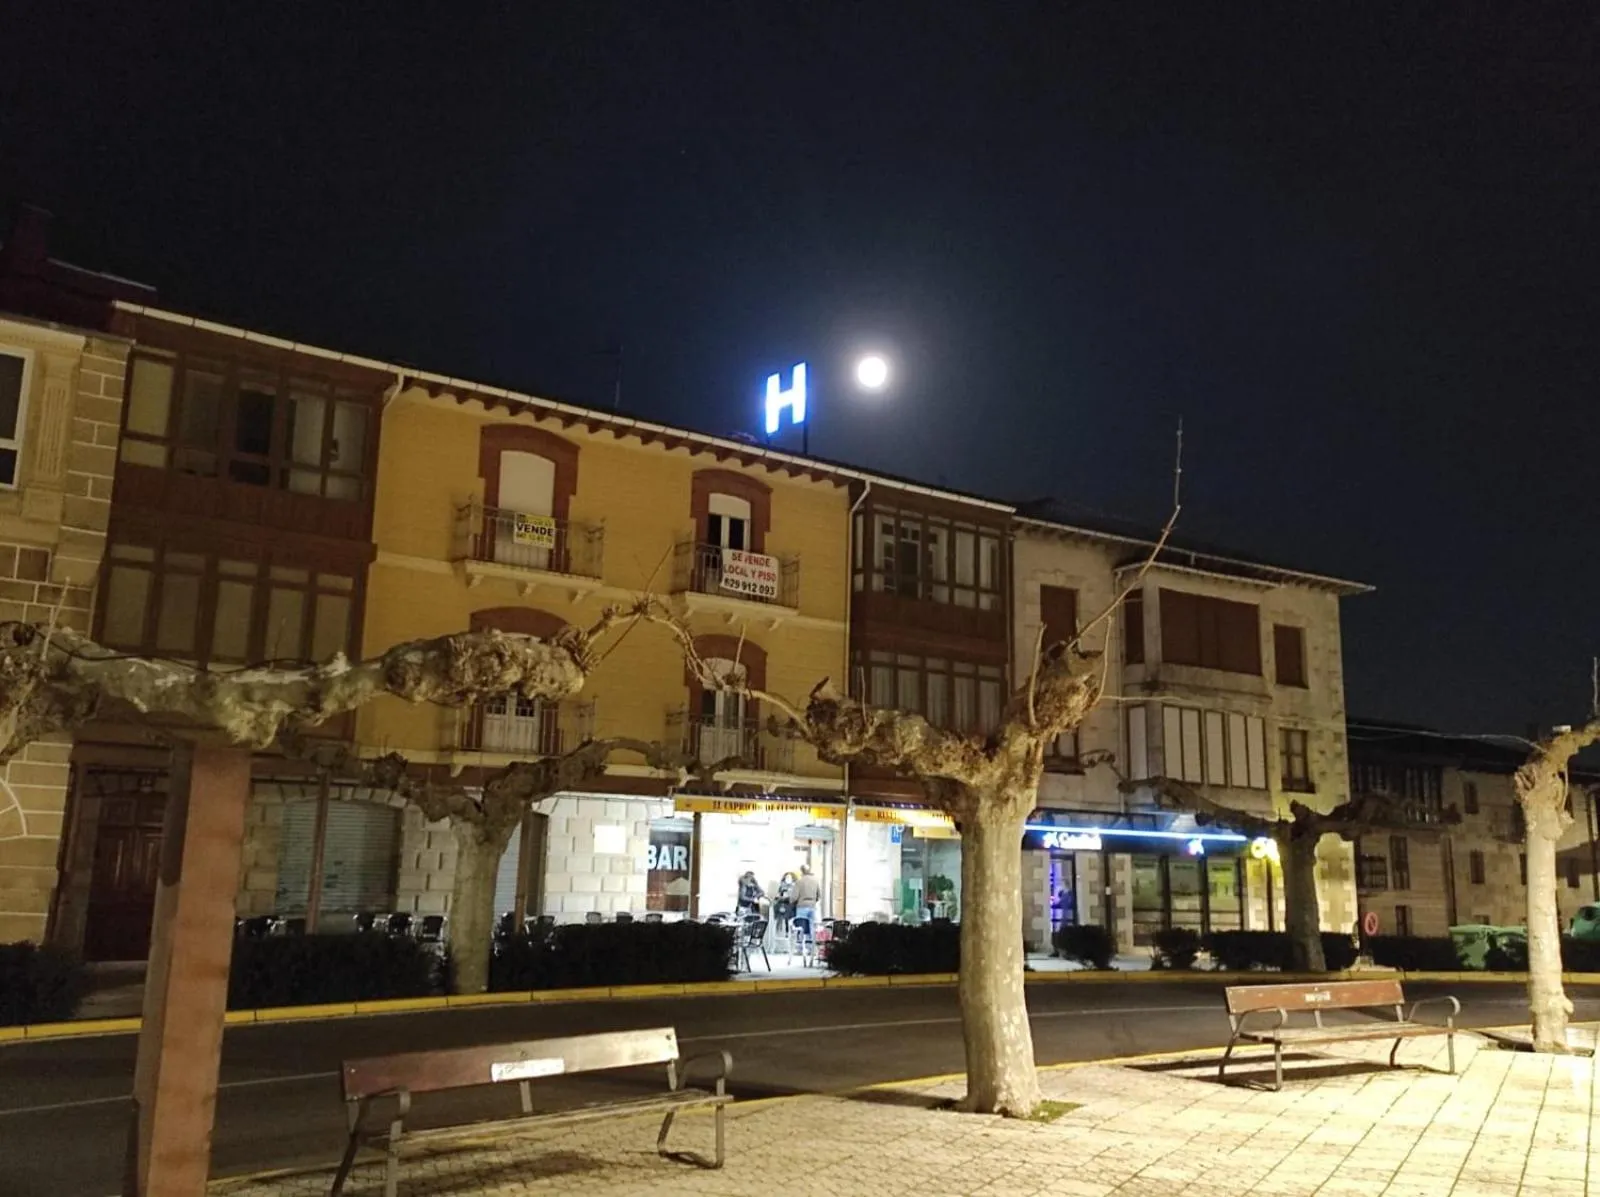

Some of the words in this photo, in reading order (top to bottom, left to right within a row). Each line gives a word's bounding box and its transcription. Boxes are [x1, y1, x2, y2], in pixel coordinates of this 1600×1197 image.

[765, 361, 806, 434] H
[516, 522, 553, 537] VENDE
[732, 552, 743, 562] SE
[723, 564, 748, 578] LOCAL
[751, 569, 757, 579] Y
[757, 570, 777, 582] PISO
[741, 581, 757, 593] 912
[646, 844, 688, 871] BAR
